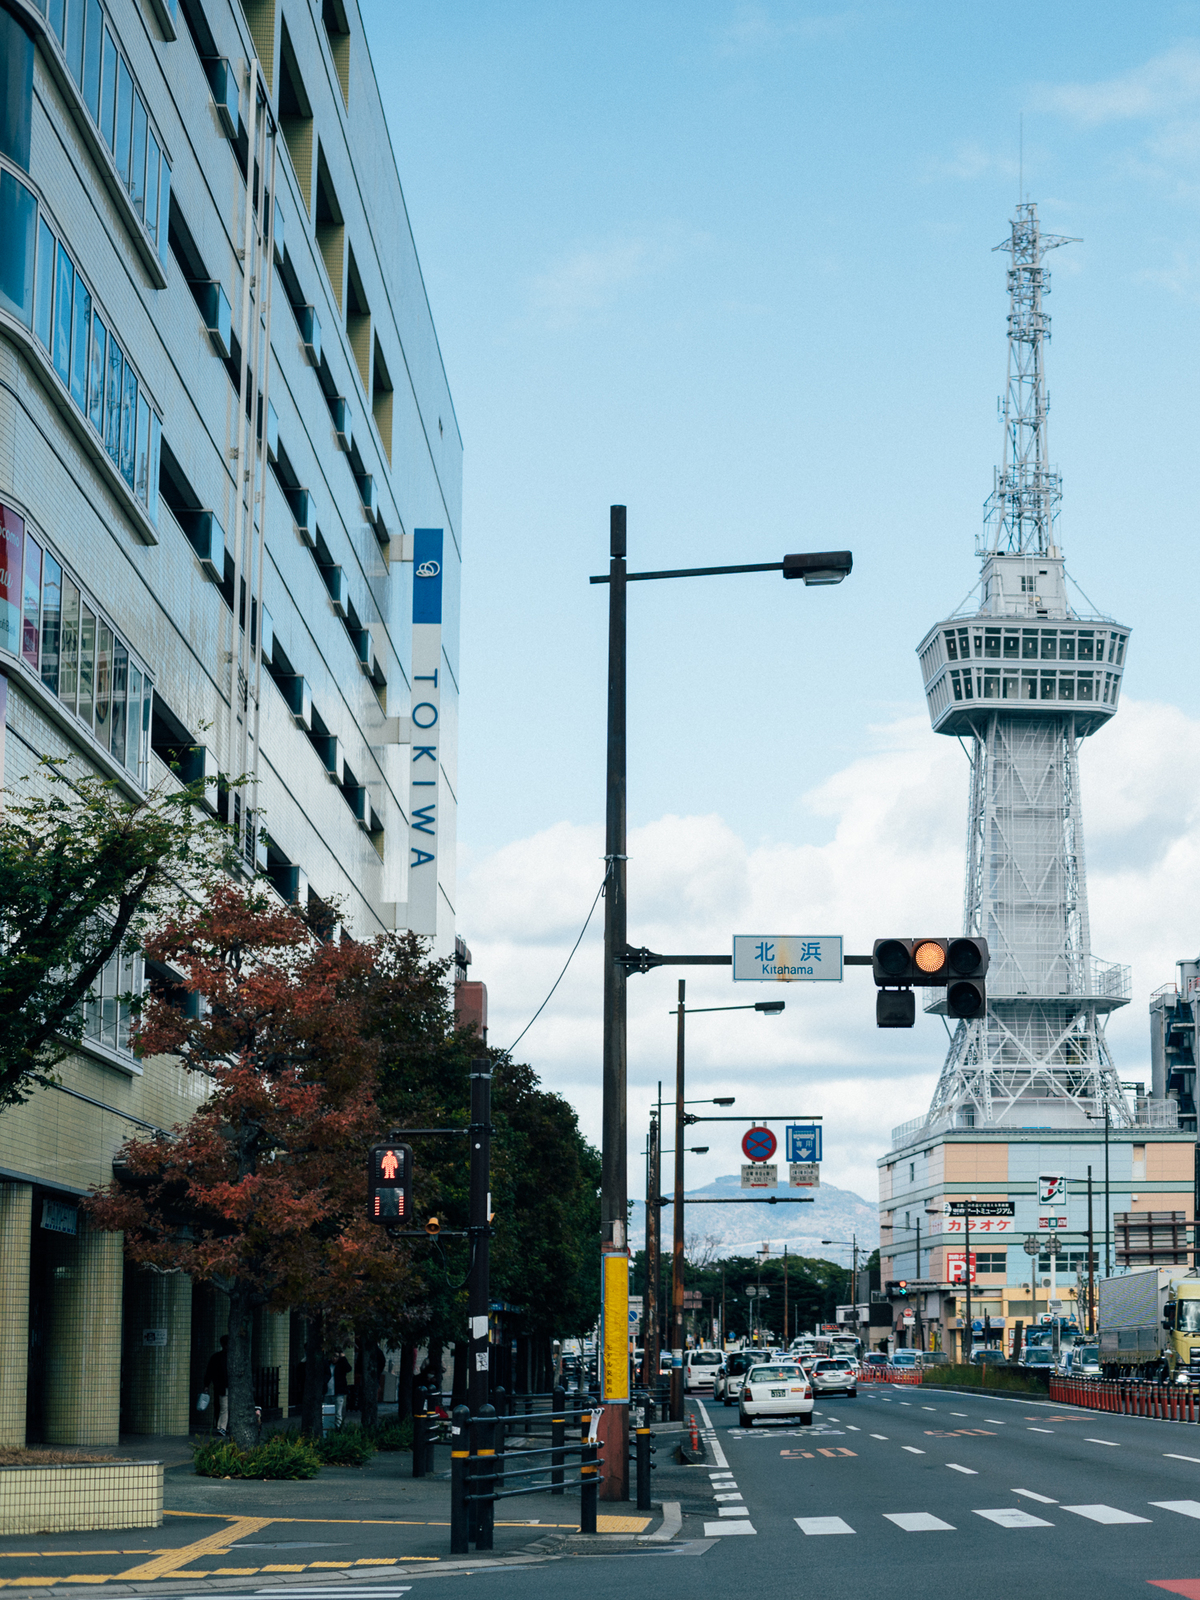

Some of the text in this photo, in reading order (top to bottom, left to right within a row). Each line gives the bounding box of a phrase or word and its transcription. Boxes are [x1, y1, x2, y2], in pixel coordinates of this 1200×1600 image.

[410, 668, 438, 868] TOKIWA
[754, 941, 822, 962] 北浜
[762, 964, 814, 975] Kitahama
[948, 1219, 1011, 1232] カラオケ
[780, 1447, 859, 1460] 50
